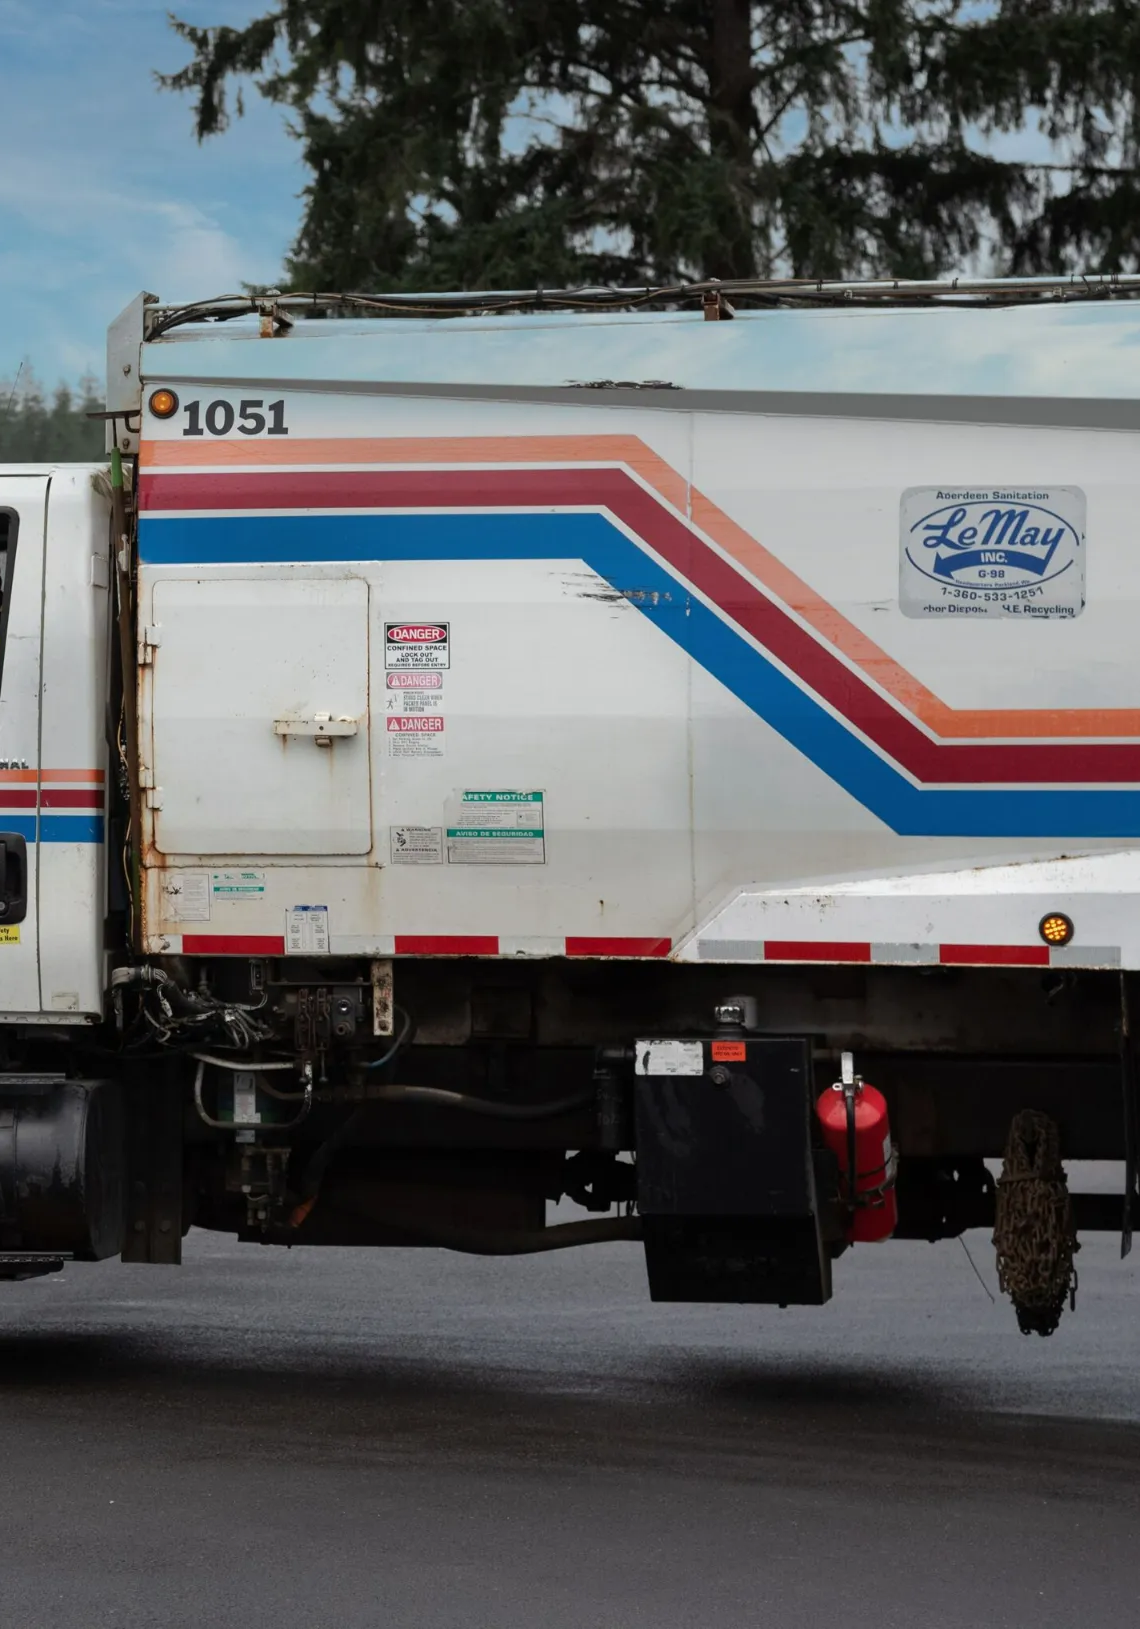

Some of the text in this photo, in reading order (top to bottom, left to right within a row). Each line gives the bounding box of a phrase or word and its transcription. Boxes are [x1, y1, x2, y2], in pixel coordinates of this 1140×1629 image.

[183, 399, 289, 436] 1051
[992, 491, 1049, 500] Sanitation
[980, 552, 1008, 563] INC.
[1023, 604, 1074, 616] Recycling
[393, 628, 440, 640] DANGER
[400, 675, 438, 686] DANGER
[401, 718, 442, 731] DANGER
